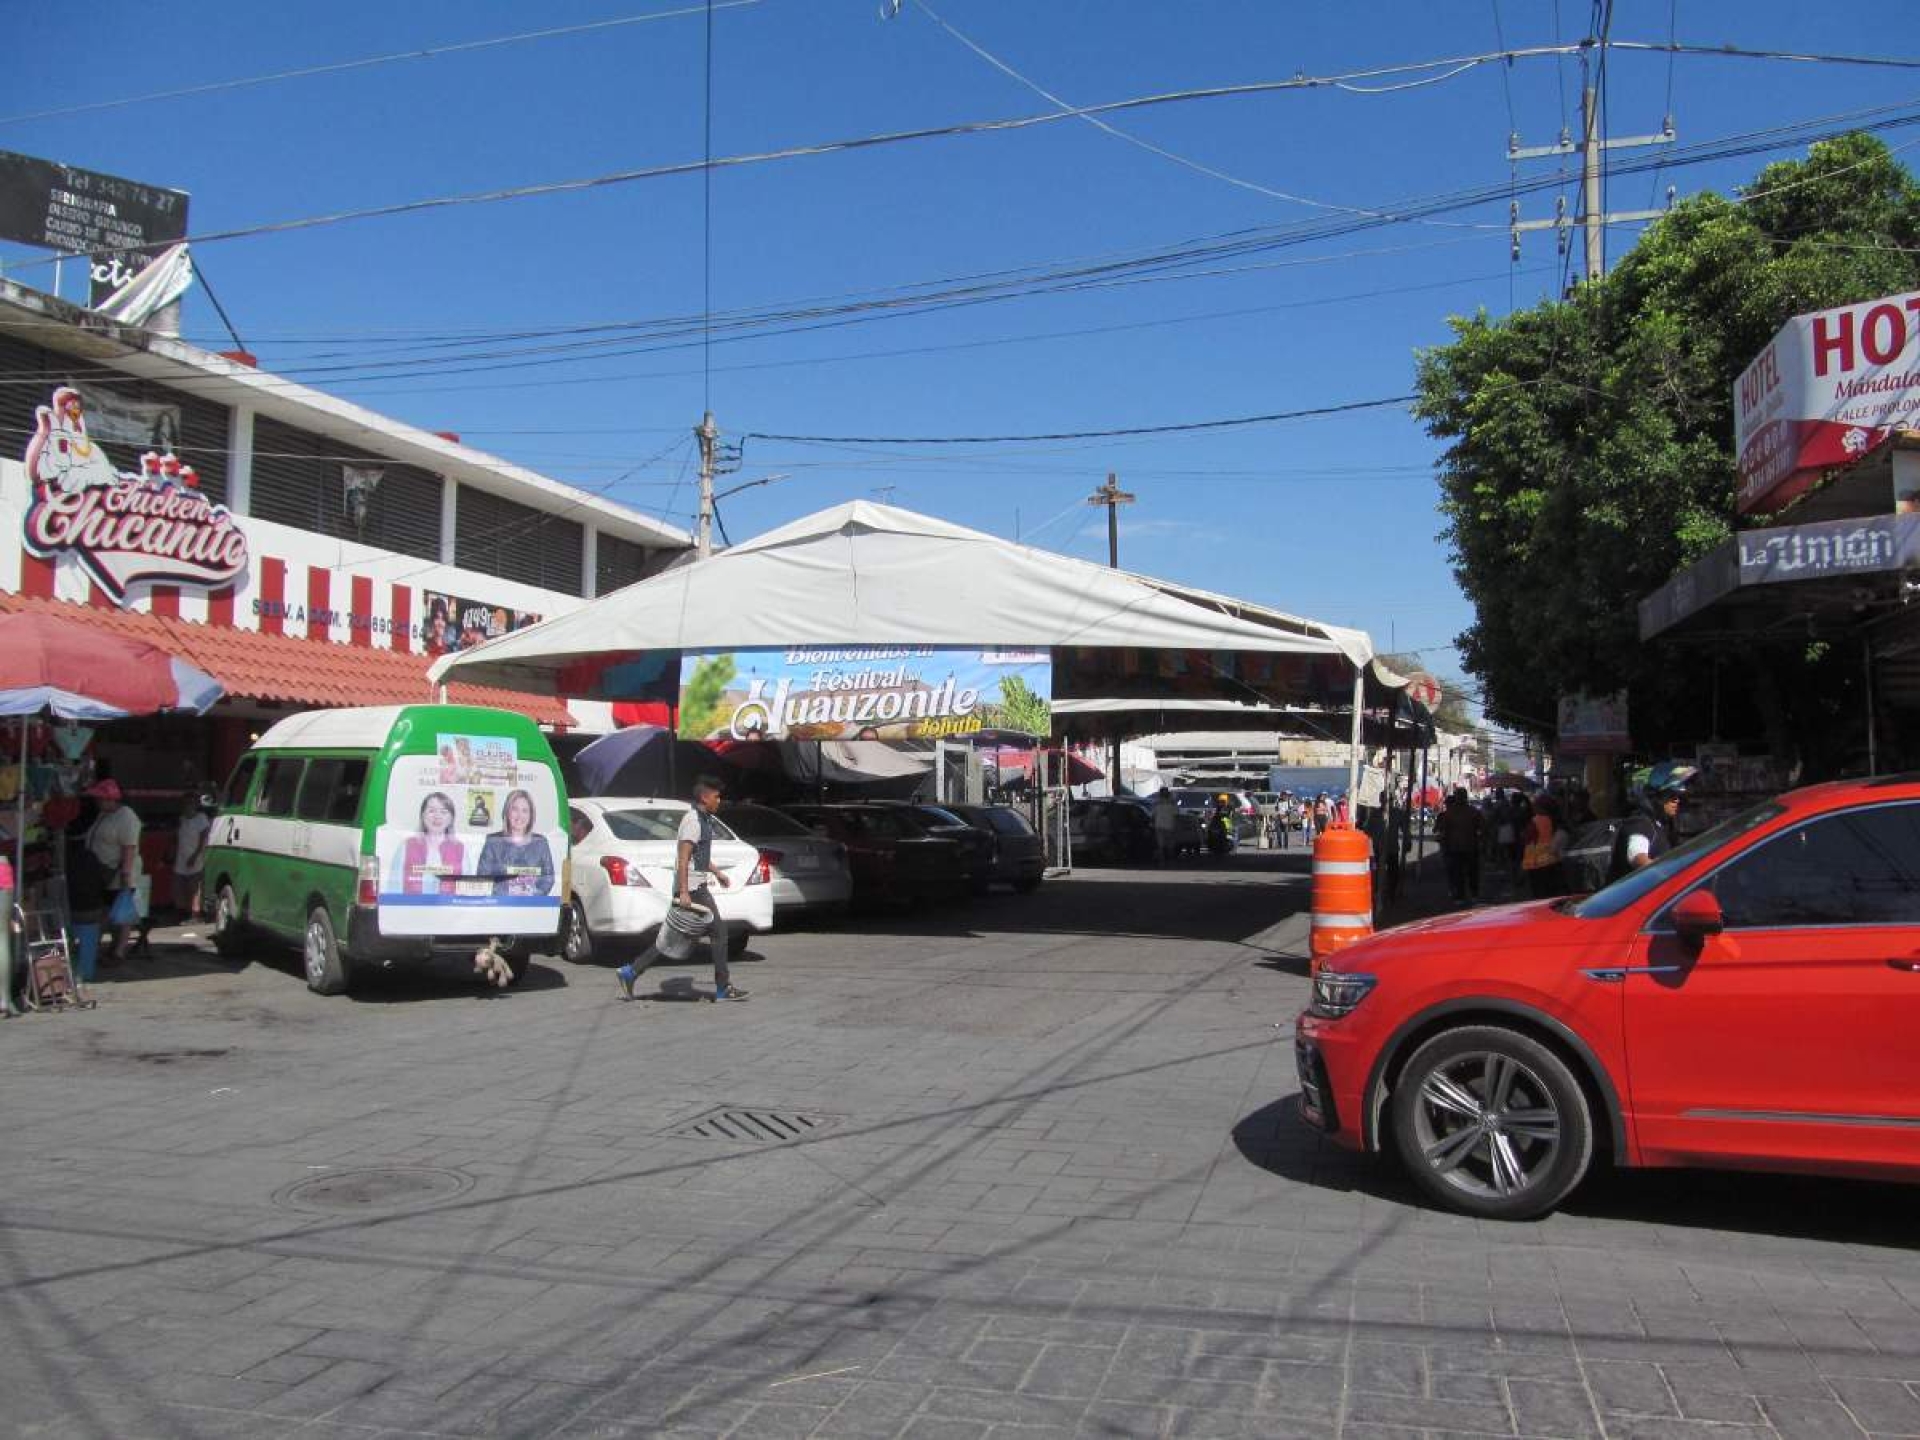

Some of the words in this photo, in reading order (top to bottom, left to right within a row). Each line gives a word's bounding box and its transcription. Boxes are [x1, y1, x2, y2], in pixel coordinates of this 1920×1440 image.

[1741, 344, 1780, 418] HOTEL
[36, 487, 248, 567] Chicanito
[106, 480, 211, 521] Chicken
[1740, 545, 1768, 566] La
[811, 664, 905, 692] Festival
[730, 674, 980, 741] Huauzontle
